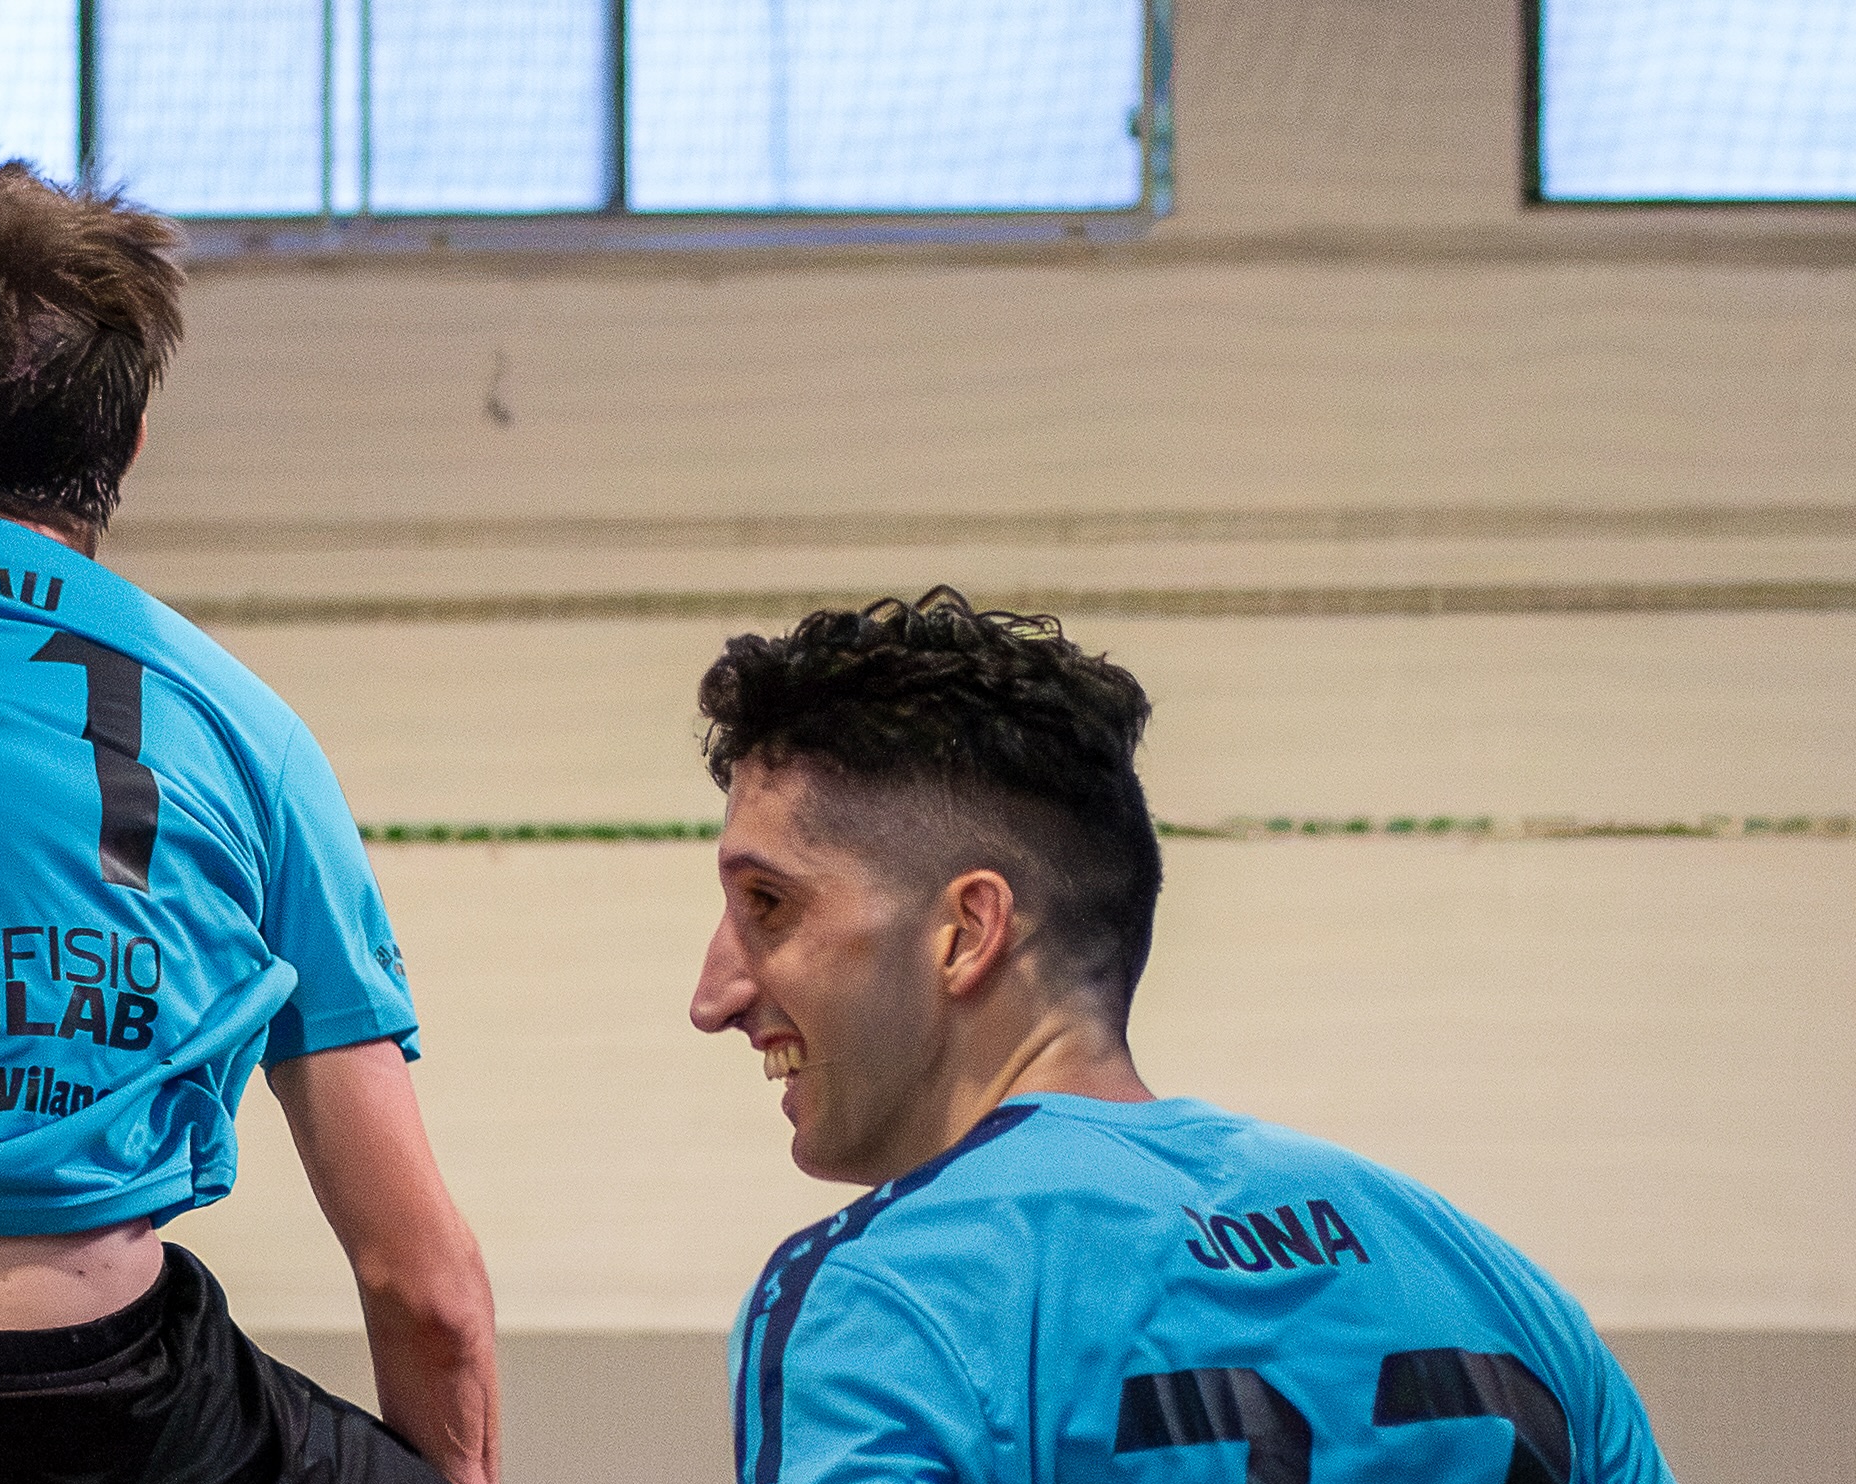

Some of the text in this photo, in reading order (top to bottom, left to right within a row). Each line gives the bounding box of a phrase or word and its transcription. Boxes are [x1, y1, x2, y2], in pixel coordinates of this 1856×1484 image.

[1, 926, 162, 995] FISIO
[5, 982, 159, 1051] LAB
[1182, 1200, 1370, 1273] JONA
